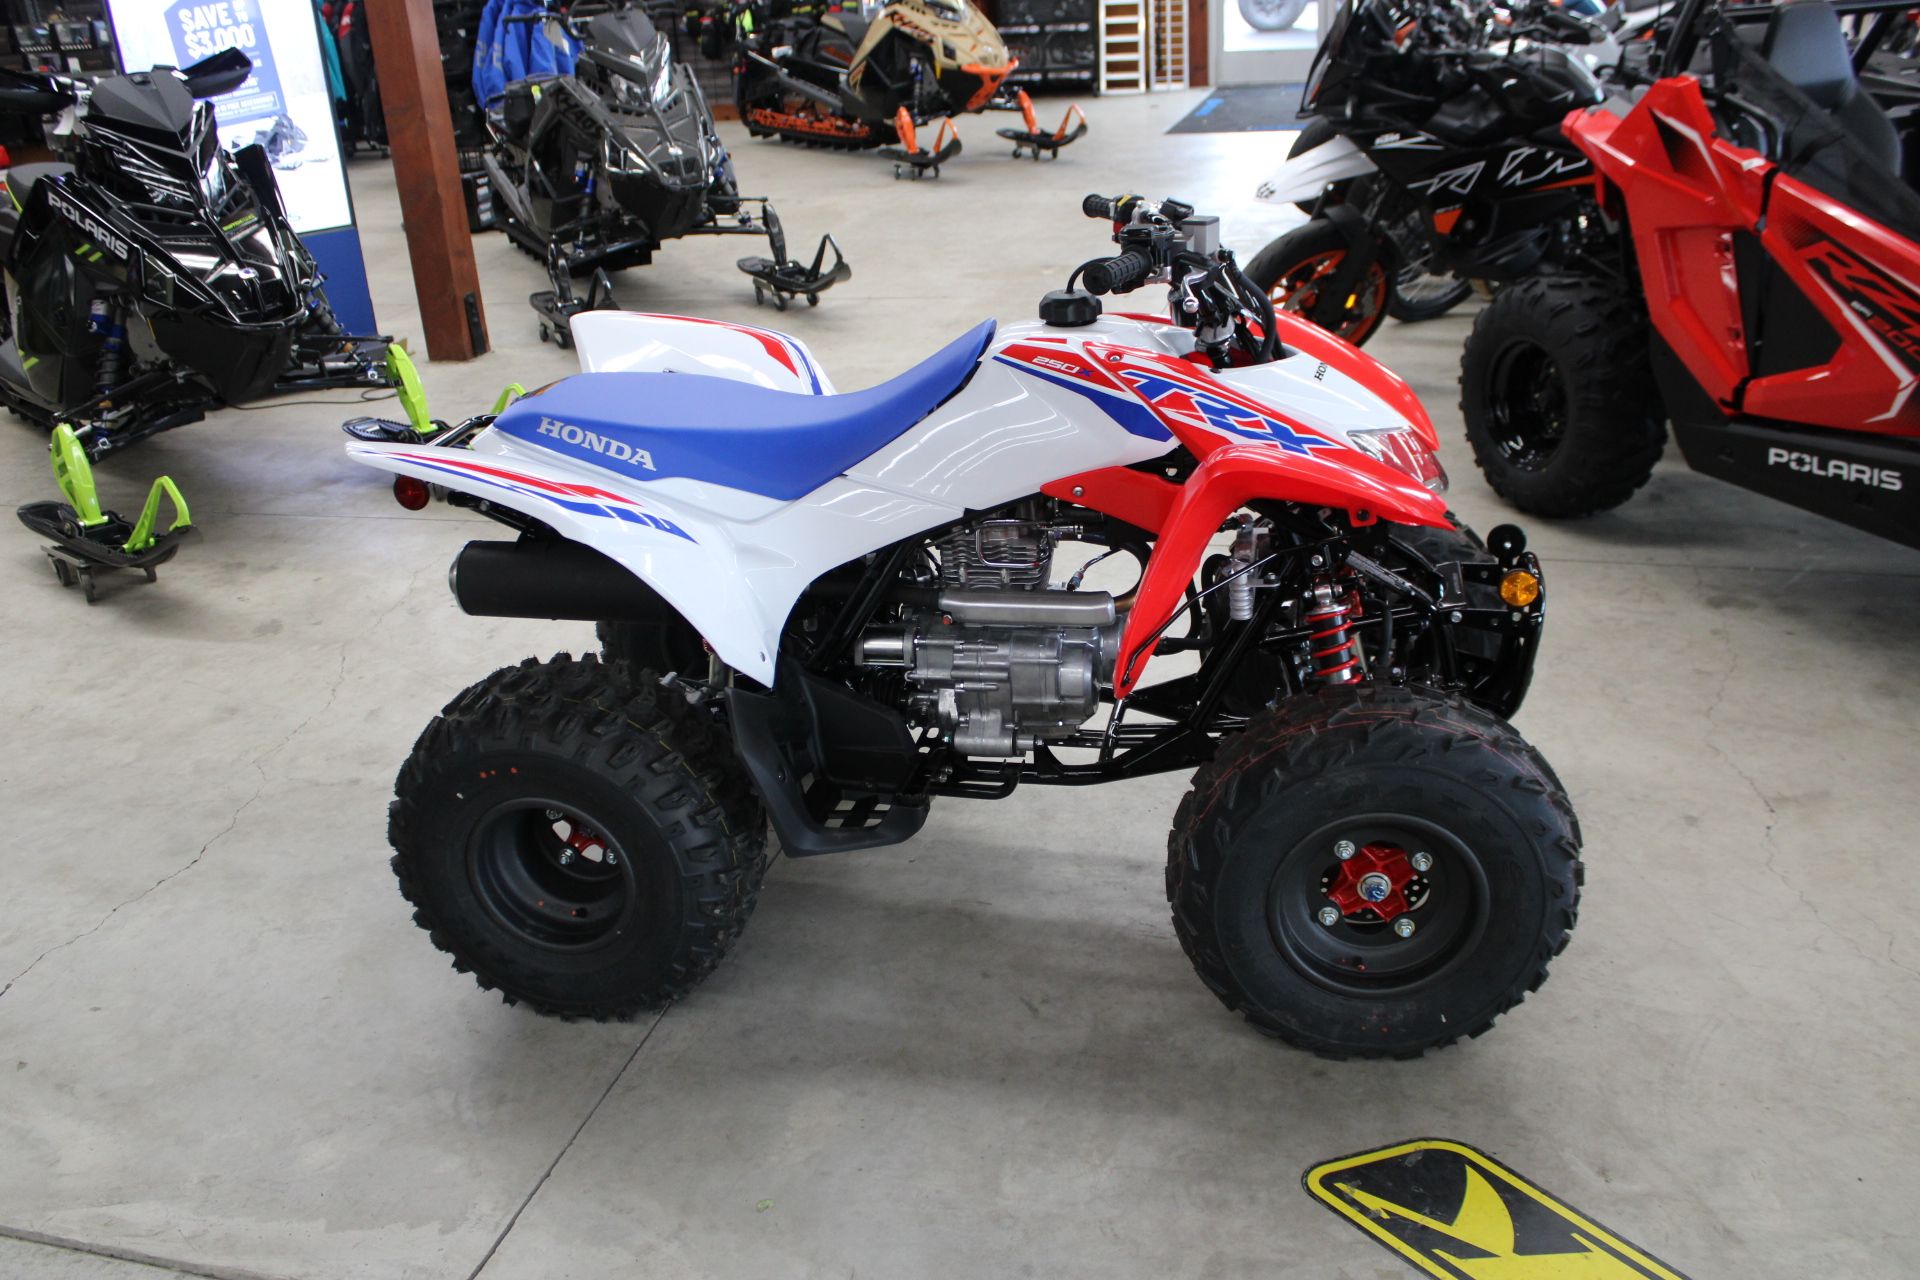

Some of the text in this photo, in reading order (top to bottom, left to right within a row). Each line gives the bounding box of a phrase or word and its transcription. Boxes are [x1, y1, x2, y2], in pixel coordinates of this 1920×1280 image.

[178, 1, 233, 33] SAVE
[48, 191, 128, 261] POLARIS
[1118, 370, 1342, 456] TRX
[536, 416, 657, 472] HONDA
[1768, 447, 1902, 491] POLARIS
